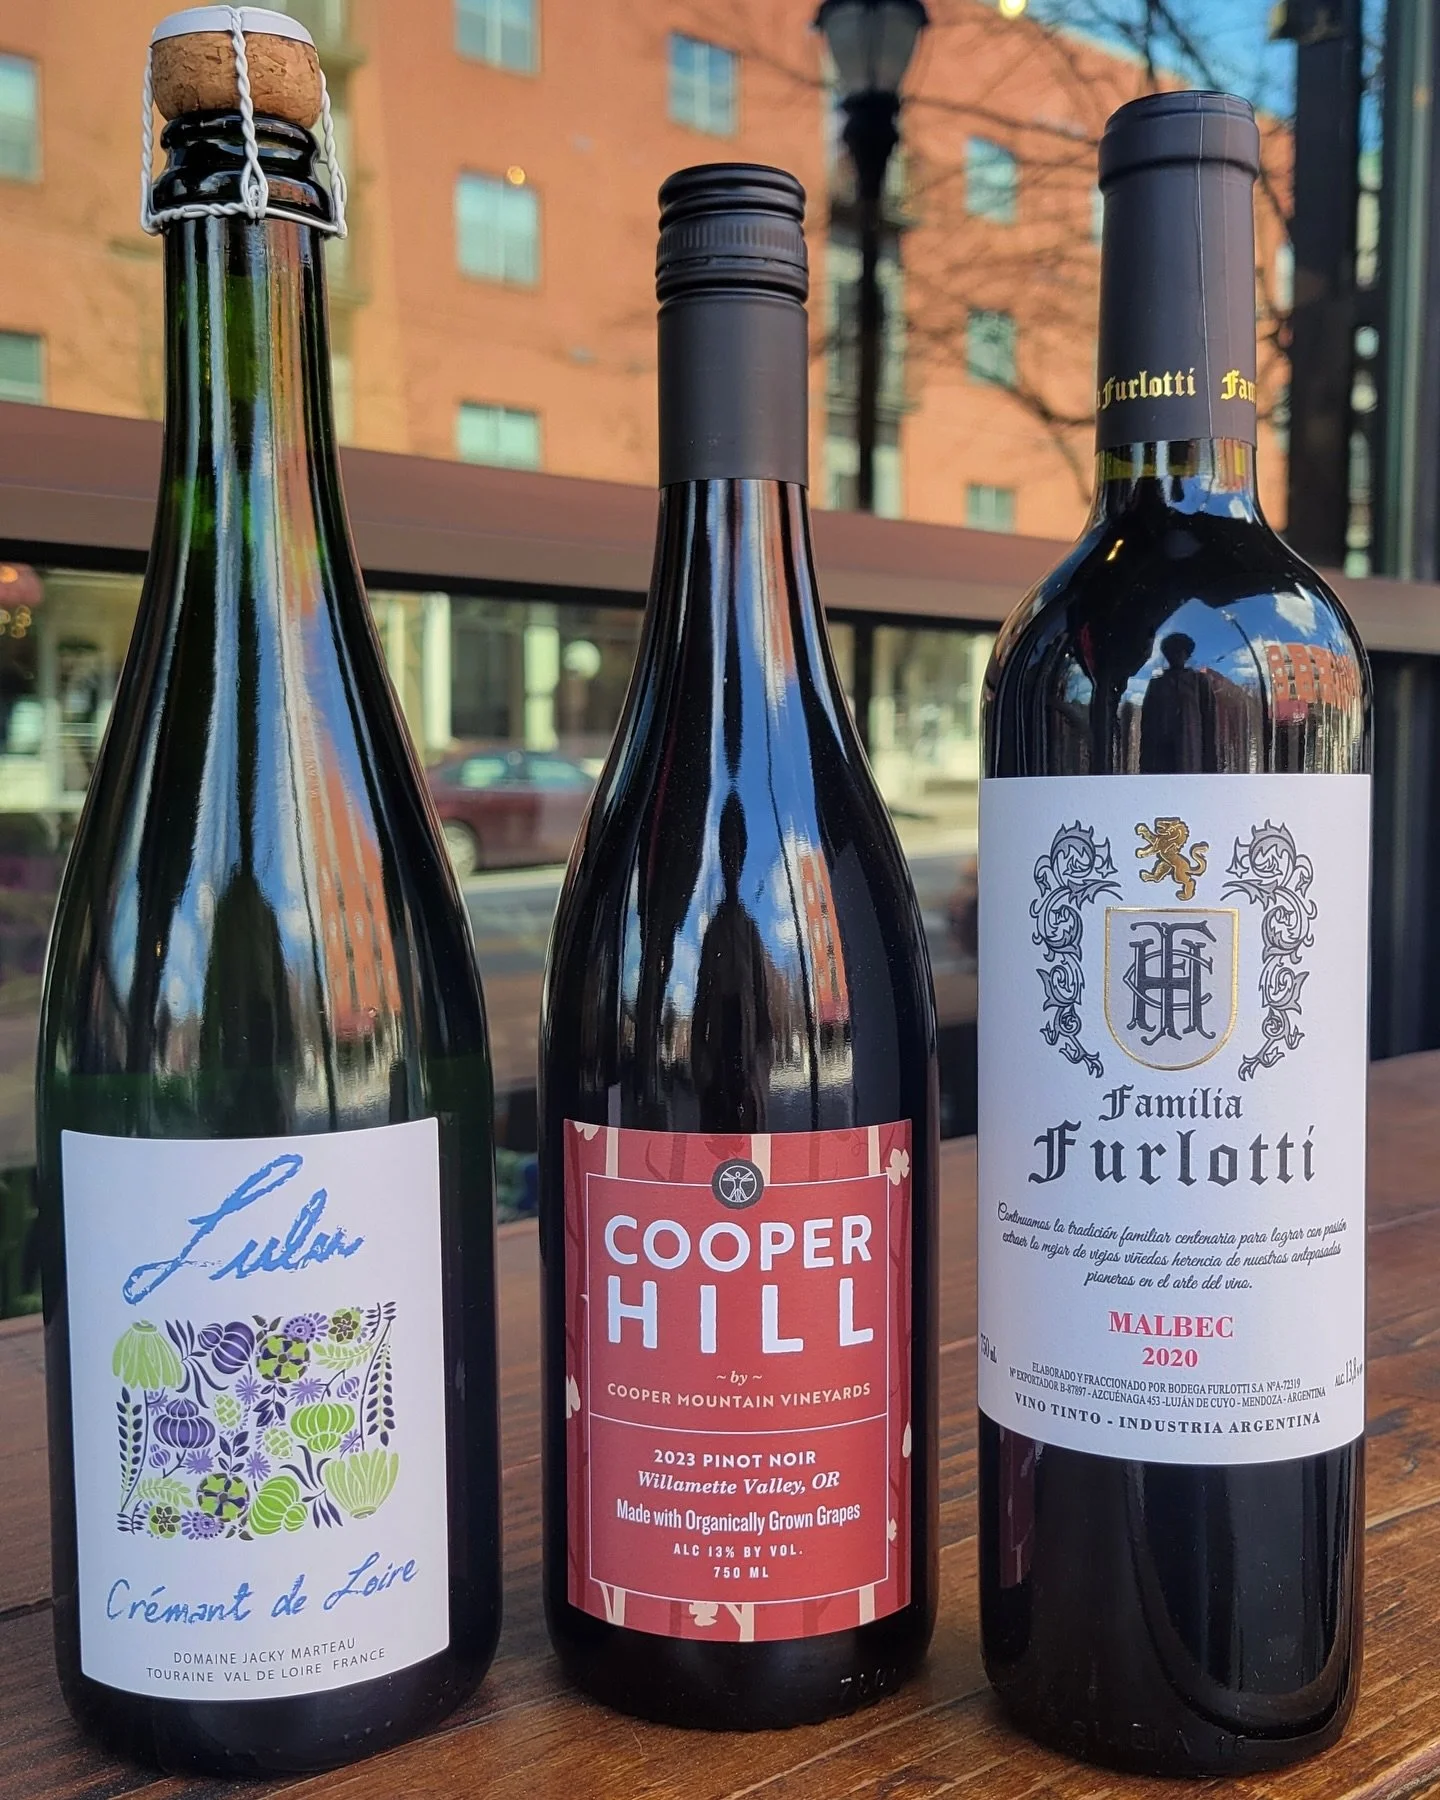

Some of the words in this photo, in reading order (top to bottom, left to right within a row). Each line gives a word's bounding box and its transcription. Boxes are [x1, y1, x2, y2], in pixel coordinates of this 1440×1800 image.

[1098, 1084, 1243, 1121] Familia
[1028, 1119, 1315, 1187] Furlotti
[123, 1153, 365, 1305] Lulu
[997, 1200, 1051, 1231] Continuamos
[1053, 1218, 1065, 1233] la
[1067, 1220, 1118, 1241] tradición
[1118, 1226, 1171, 1247] familiar
[1175, 1230, 1236, 1245] centenaria
[1237, 1233, 1268, 1249] para
[1270, 1227, 1304, 1248] lograr
[1306, 1227, 1322, 1238] con
[1322, 1218, 1347, 1241] pasión
[604, 1214, 872, 1272] COOPER
[1002, 1230, 1028, 1247] extraer
[1030, 1236, 1039, 1250] lo
[1041, 1243, 1070, 1259] mejor
[1073, 1244, 1087, 1259] de
[1089, 1249, 1121, 1267] viejos
[1124, 1251, 1168, 1266] viñedos
[1171, 1251, 1222, 1267] herencia
[1226, 1251, 1241, 1267] de
[1242, 1250, 1288, 1267] nuestros
[1291, 1240, 1342, 1266] antepasados
[1083, 1271, 1135, 1286] pioneros
[1139, 1275, 1153, 1287] en
[1157, 1273, 1170, 1288] el
[1172, 1275, 1198, 1290] arte
[1201, 1274, 1223, 1290] del
[1224, 1278, 1253, 1289] vino.
[607, 1275, 874, 1354] HILL
[1108, 1310, 1234, 1338] MALBEC
[1142, 1347, 1198, 1367] 2020
[607, 1382, 671, 1404] COOPER
[677, 1393, 774, 1408] MOUNTAIN
[780, 1383, 871, 1406] VINEYARDS
[730, 1370, 748, 1386] by
[1016, 1369, 1059, 1390] EXPORTADOR
[1060, 1382, 1087, 1397] B-87897
[1091, 1389, 1146, 1404] AZCUÉNAGA
[1147, 1395, 1160, 1406] 453
[1196, 1398, 1208, 1408] DE
[1210, 1398, 1236, 1408] CUYO
[1241, 1394, 1283, 1407] MENDOZA
[1287, 1386, 1326, 1402] ARGENTINA
[1032, 1361, 1076, 1381] ELABORADO
[1076, 1372, 1083, 1381] Y
[1084, 1375, 1147, 1391] FRACCIONADO
[1148, 1381, 1166, 1393] POR
[1168, 1383, 1206, 1394] BODEGA
[1207, 1383, 1250, 1394] FURLOTTI
[1015, 1392, 1046, 1412] VINO
[1051, 1404, 1101, 1425] TINTO
[1119, 1416, 1223, 1434] INDUSTRIA
[1228, 1411, 1321, 1433] ARGENTINA
[654, 1450, 696, 1466] 2023
[703, 1454, 762, 1468] PINOT
[769, 1451, 816, 1467] NOIR
[638, 1471, 737, 1494] Willamette
[743, 1478, 806, 1495] Valley,
[811, 1471, 840, 1489] OR
[617, 1499, 651, 1524] Made
[653, 1508, 682, 1529] with
[685, 1509, 765, 1536] Organically
[769, 1511, 813, 1531] Grown
[817, 1503, 861, 1527] Grapes
[673, 1543, 700, 1556] ALC
[708, 1546, 735, 1558] 13%
[744, 1546, 761, 1557] BY
[770, 1544, 803, 1557] VOL.
[106, 1578, 256, 1624] Crémant
[271, 1574, 308, 1618] de
[323, 1551, 417, 1611] Loire
[713, 1567, 741, 1578] 750
[749, 1567, 769, 1578] ML
[146, 1667, 214, 1683] TOURAINE
[224, 1670, 250, 1682] VAL
[256, 1669, 276, 1681] DE
[281, 1663, 322, 1679] LOIRE
[333, 1647, 386, 1671] FRANCE
[173, 1651, 237, 1665] DOMAINE
[242, 1650, 286, 1663] JACKY
[291, 1637, 356, 1659] MARTEAU
